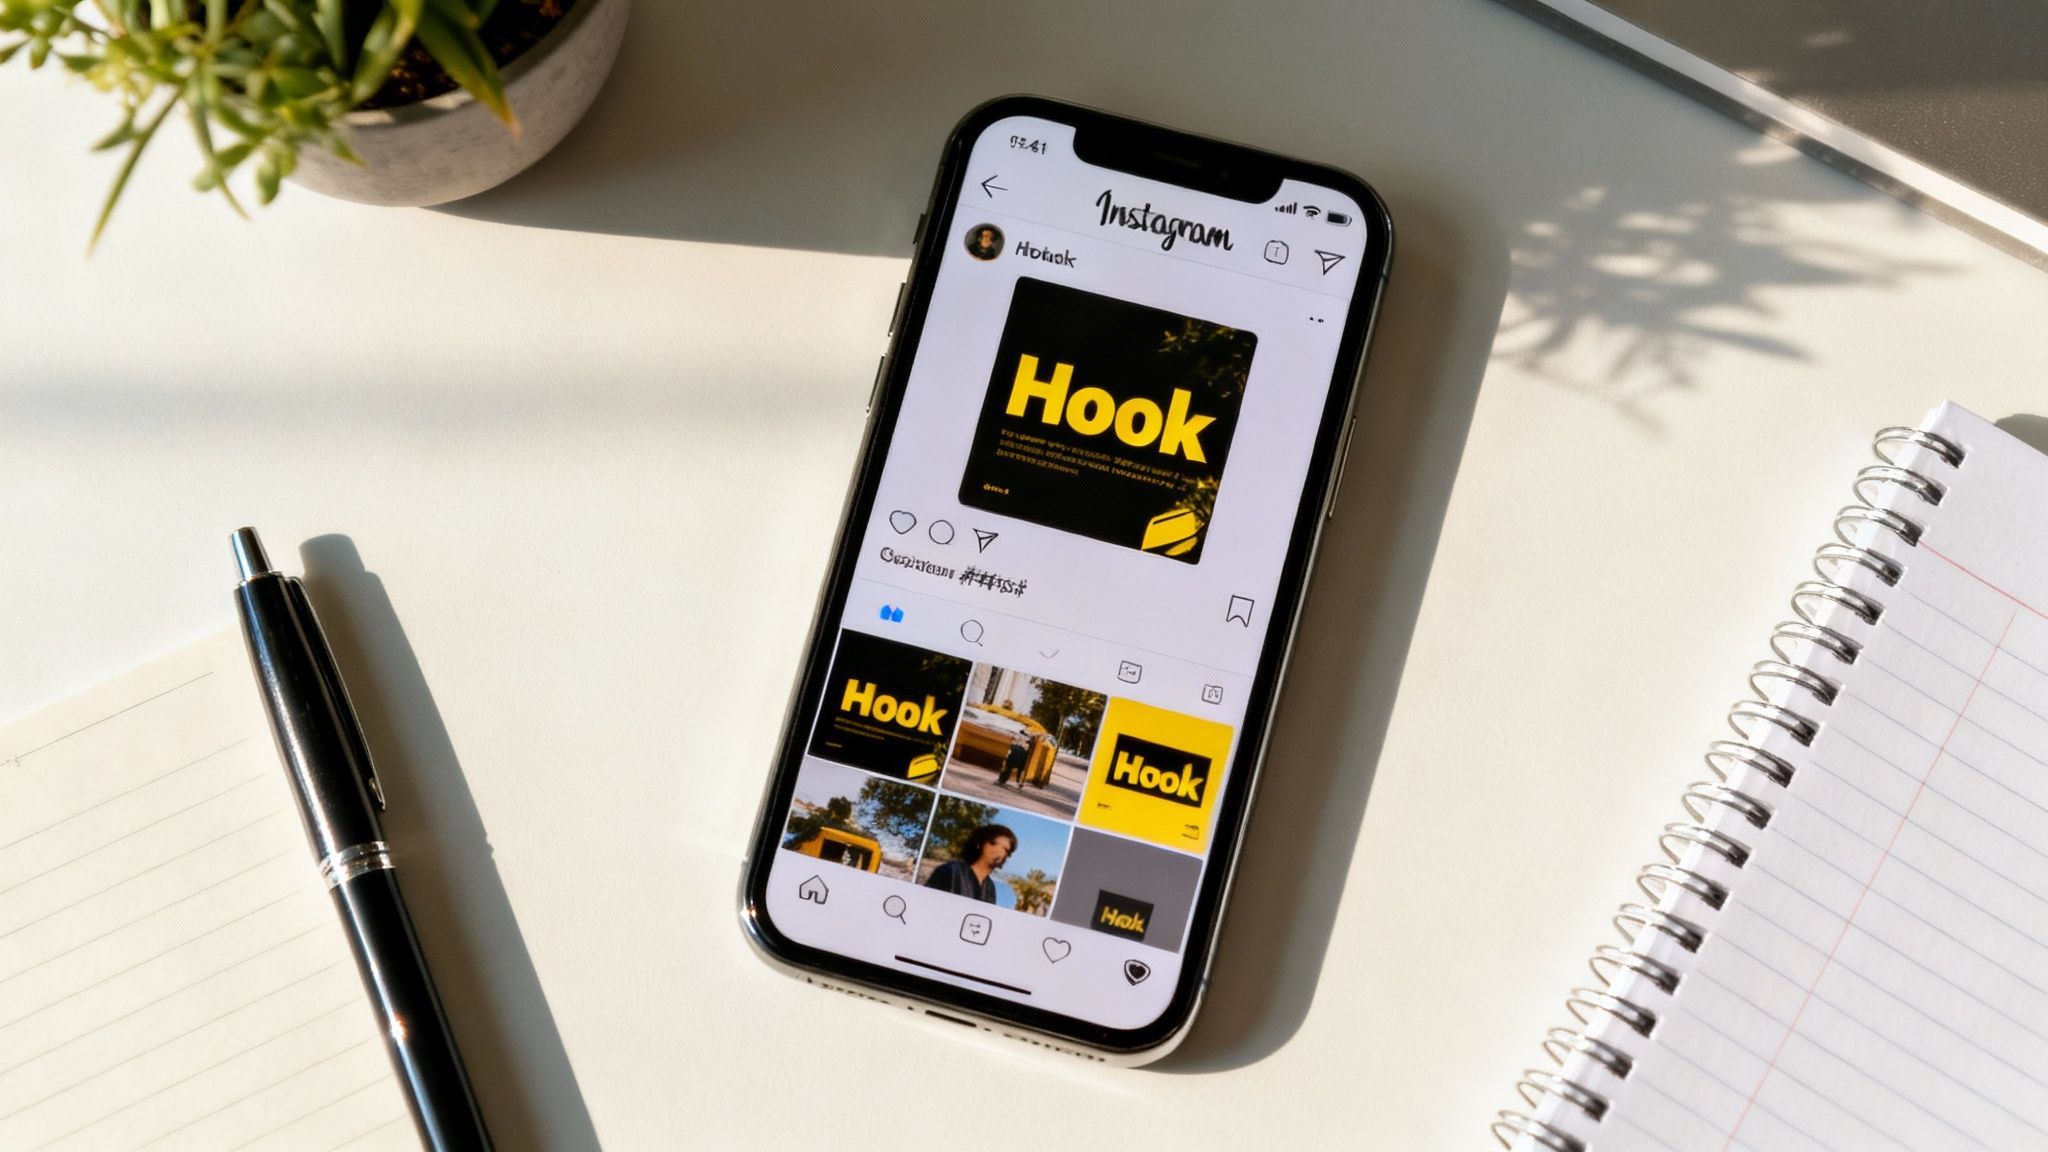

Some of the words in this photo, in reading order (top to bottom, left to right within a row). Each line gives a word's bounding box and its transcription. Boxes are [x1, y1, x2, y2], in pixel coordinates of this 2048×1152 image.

[1095, 189, 1234, 251] Instagram
[1005, 353, 1217, 464] Hook
[840, 678, 948, 736] Hook
[1113, 751, 1204, 802] Hook
